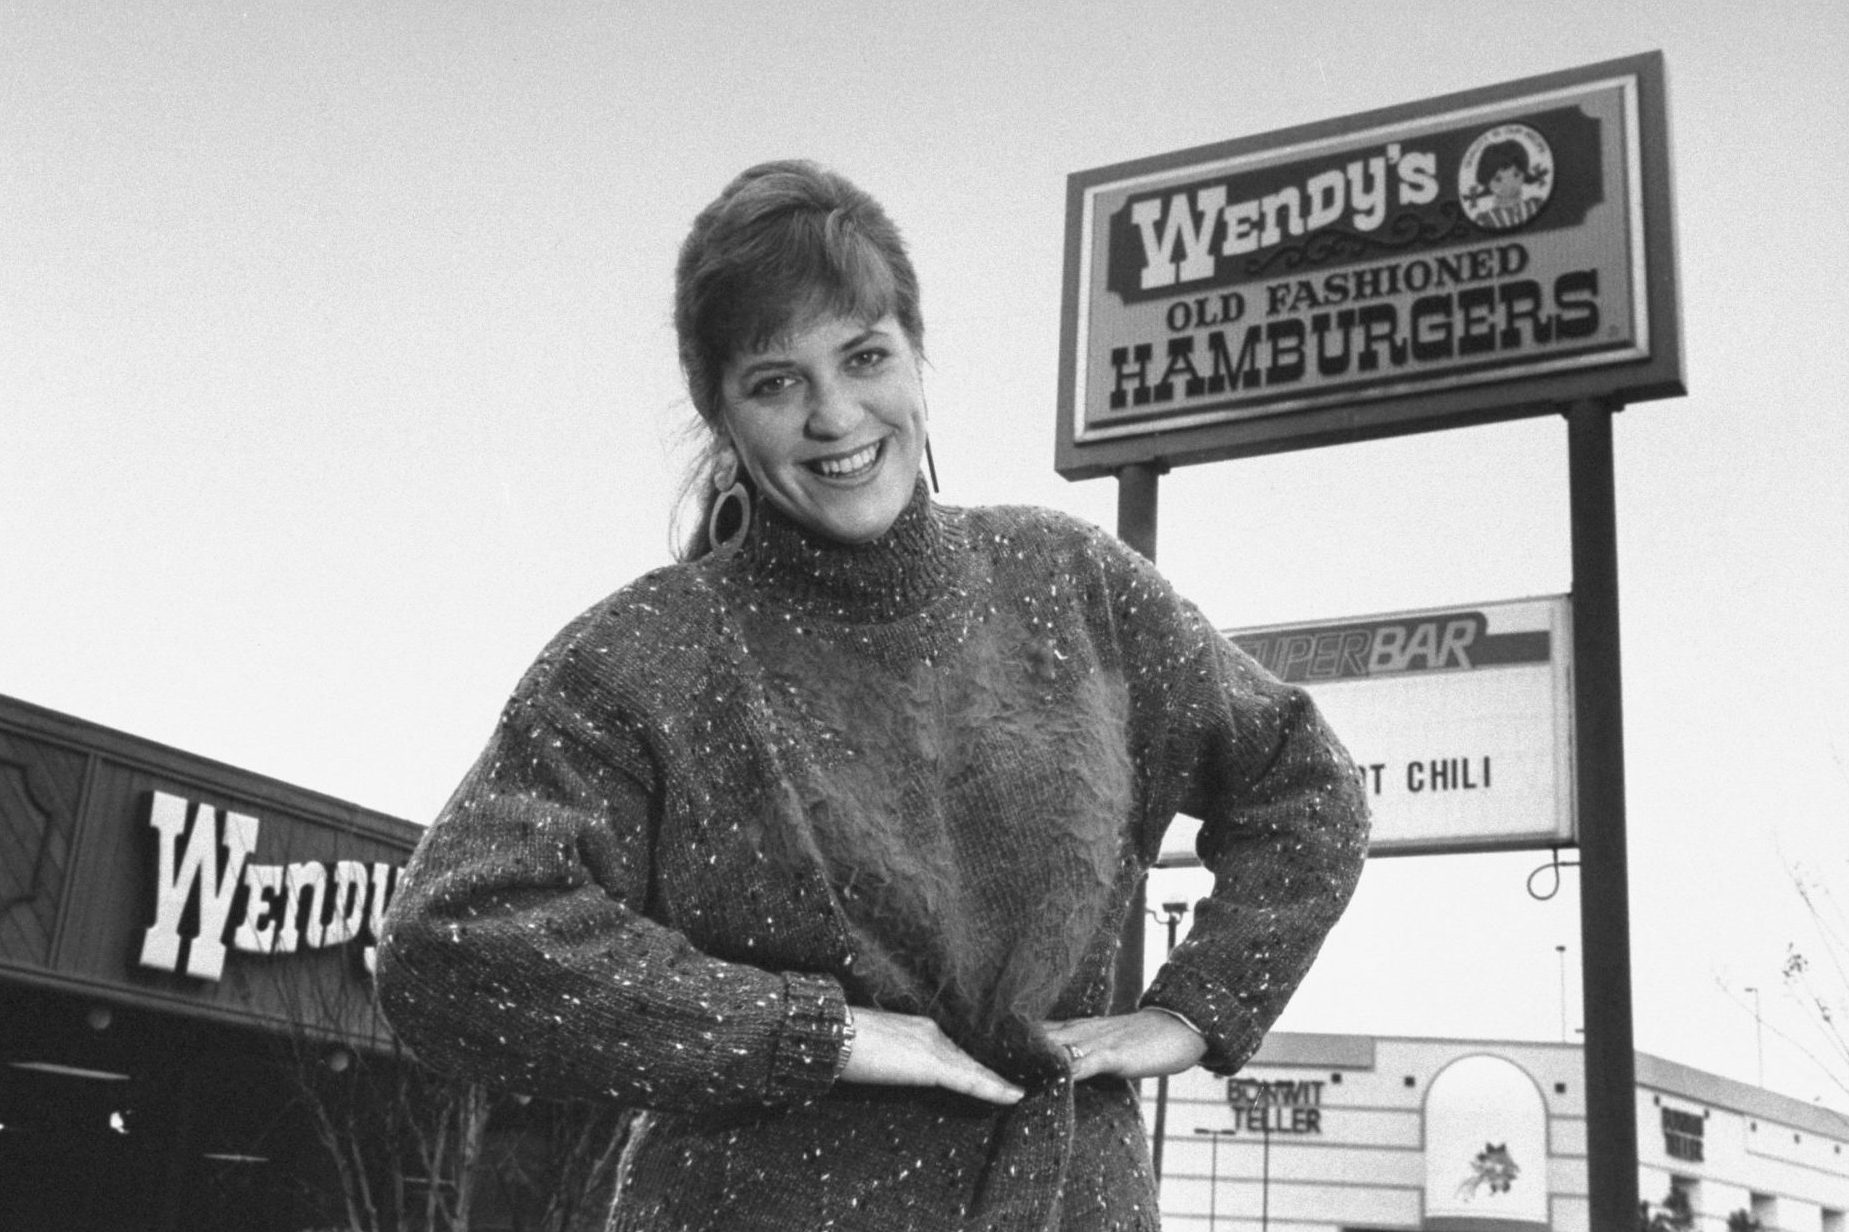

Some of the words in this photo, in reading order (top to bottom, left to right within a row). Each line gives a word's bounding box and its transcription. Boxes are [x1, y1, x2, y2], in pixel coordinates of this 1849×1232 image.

[1166, 292, 1245, 333] OLD
[1266, 242, 1530, 317] FASHIONED
[1109, 268, 1601, 410] HAMBURGERS
[1407, 755, 1491, 793] CHILI
[1231, 1104, 1321, 1134] TELLER
